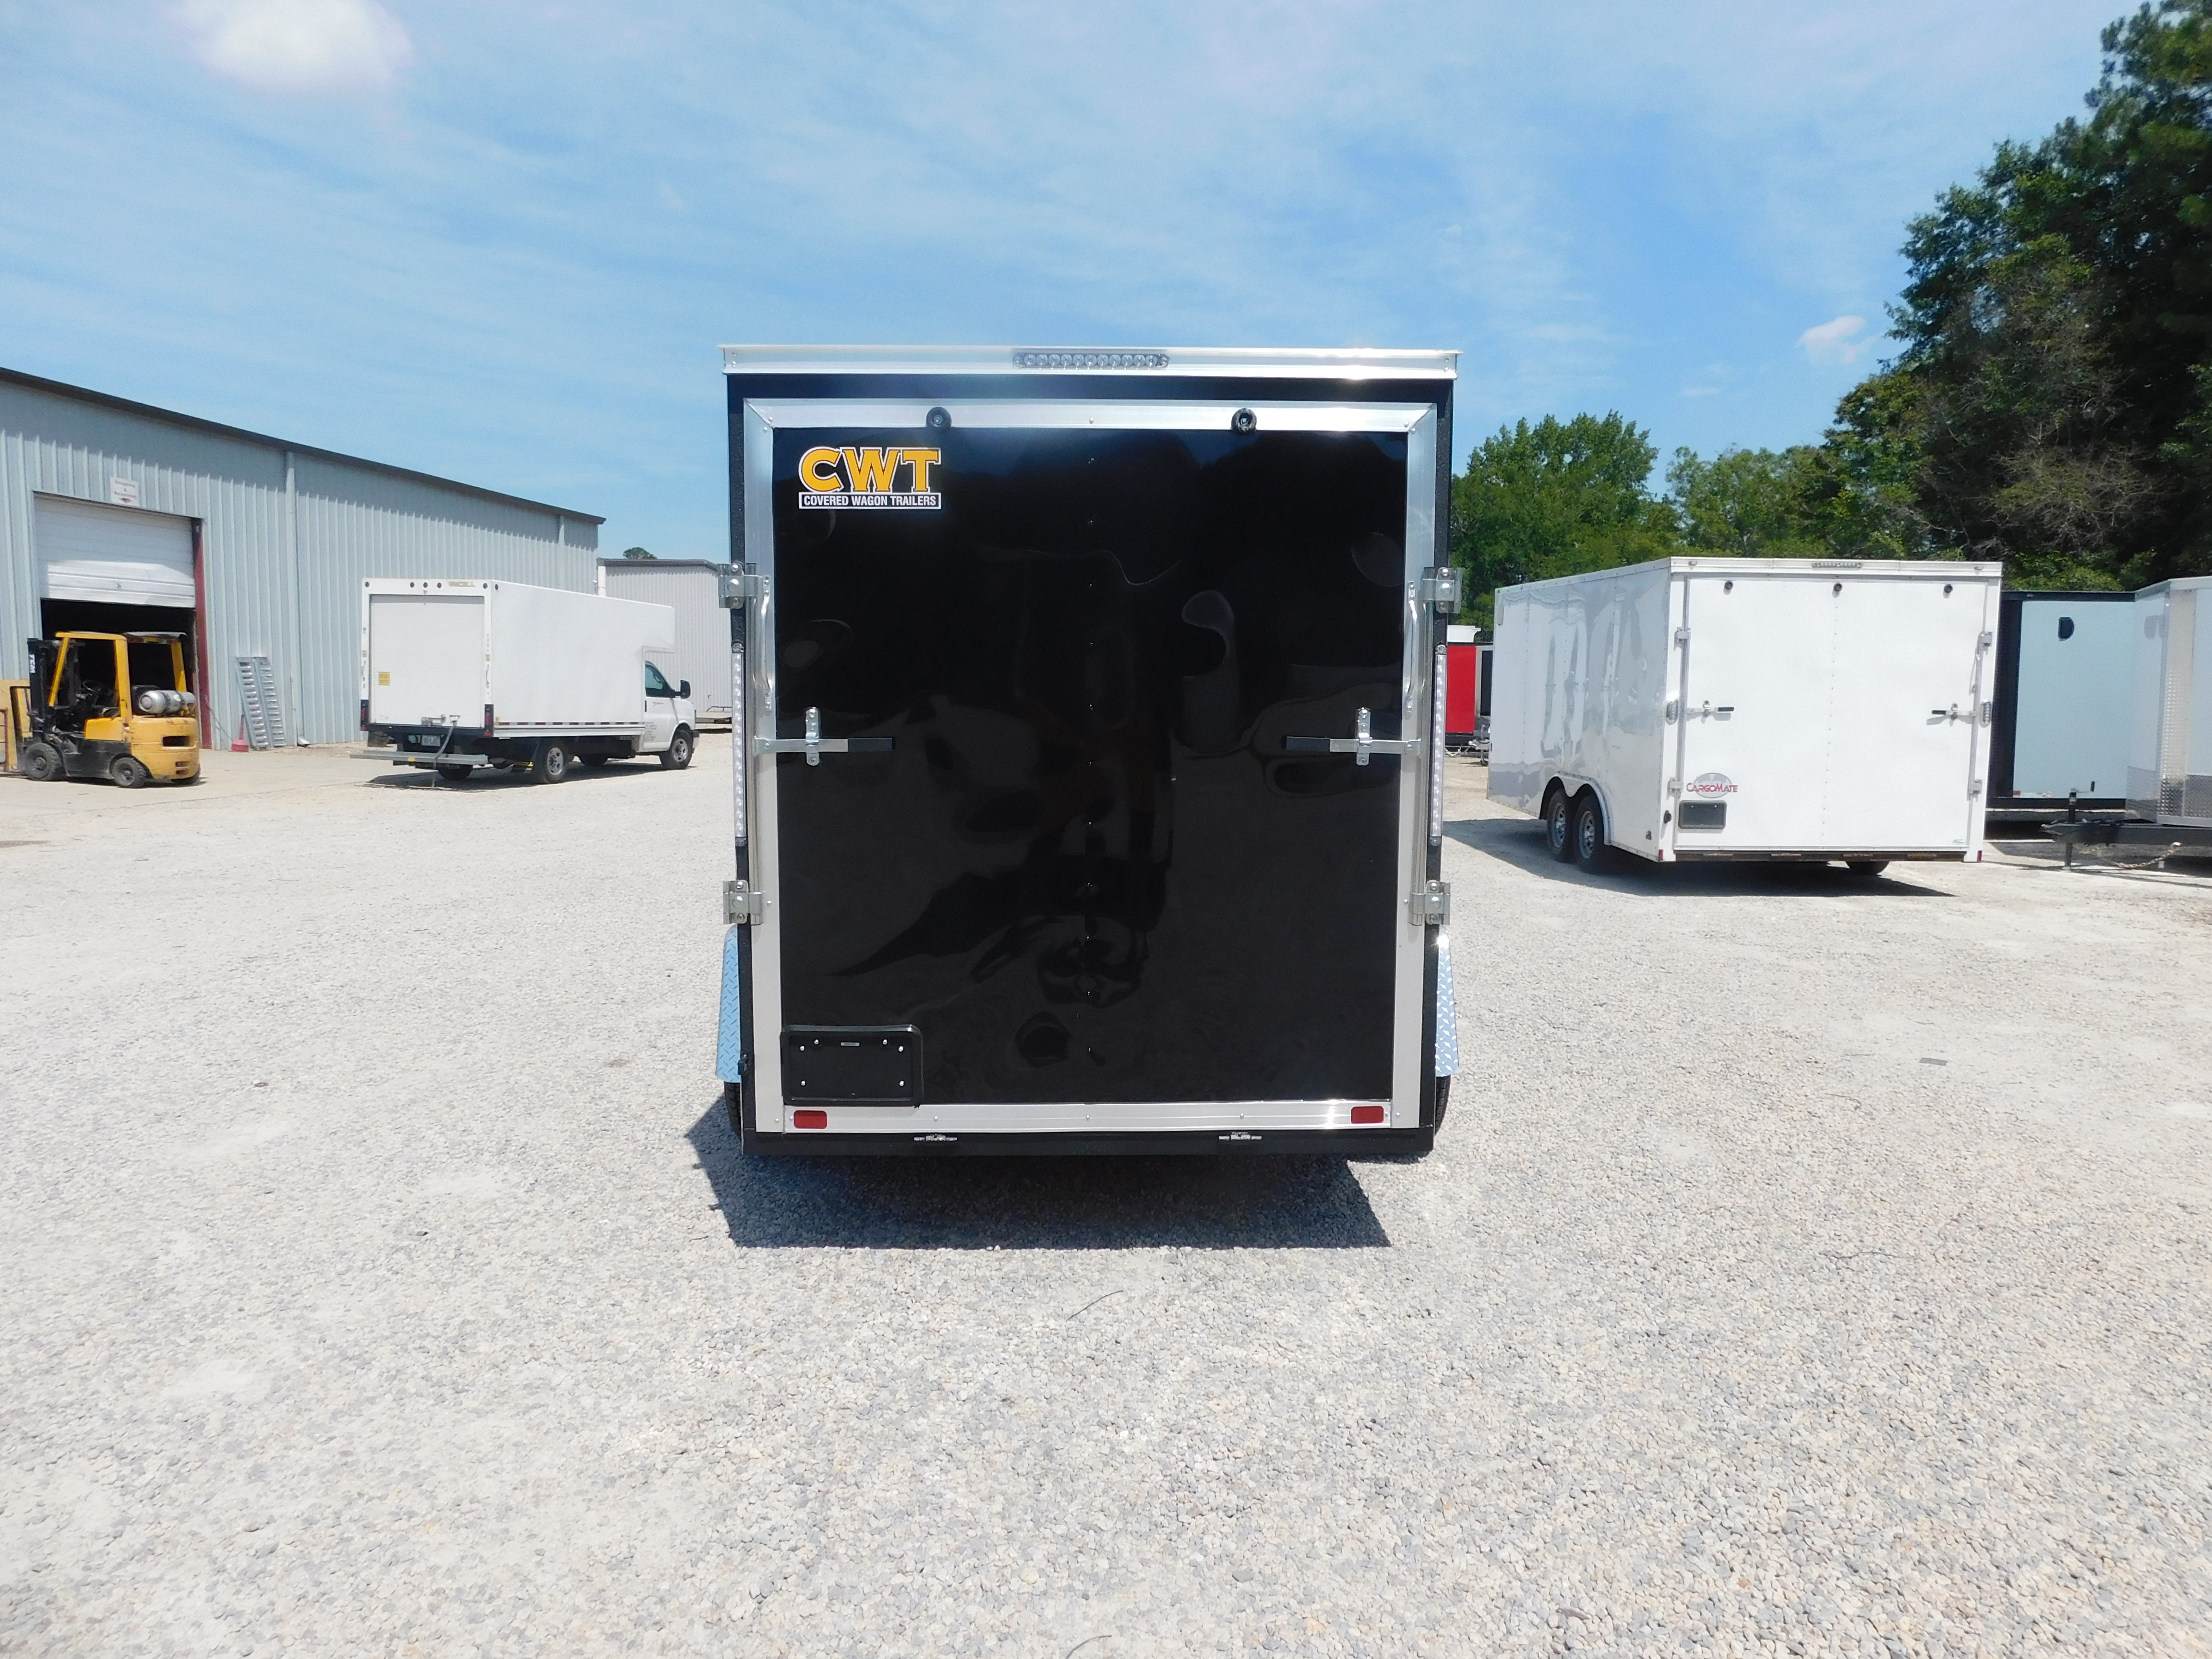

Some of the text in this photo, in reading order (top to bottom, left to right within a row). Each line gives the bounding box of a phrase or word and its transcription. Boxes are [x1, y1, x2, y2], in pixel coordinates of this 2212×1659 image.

[799, 446, 941, 493] CWT
[804, 495, 937, 506] COVERED WAGON TRAILERS
